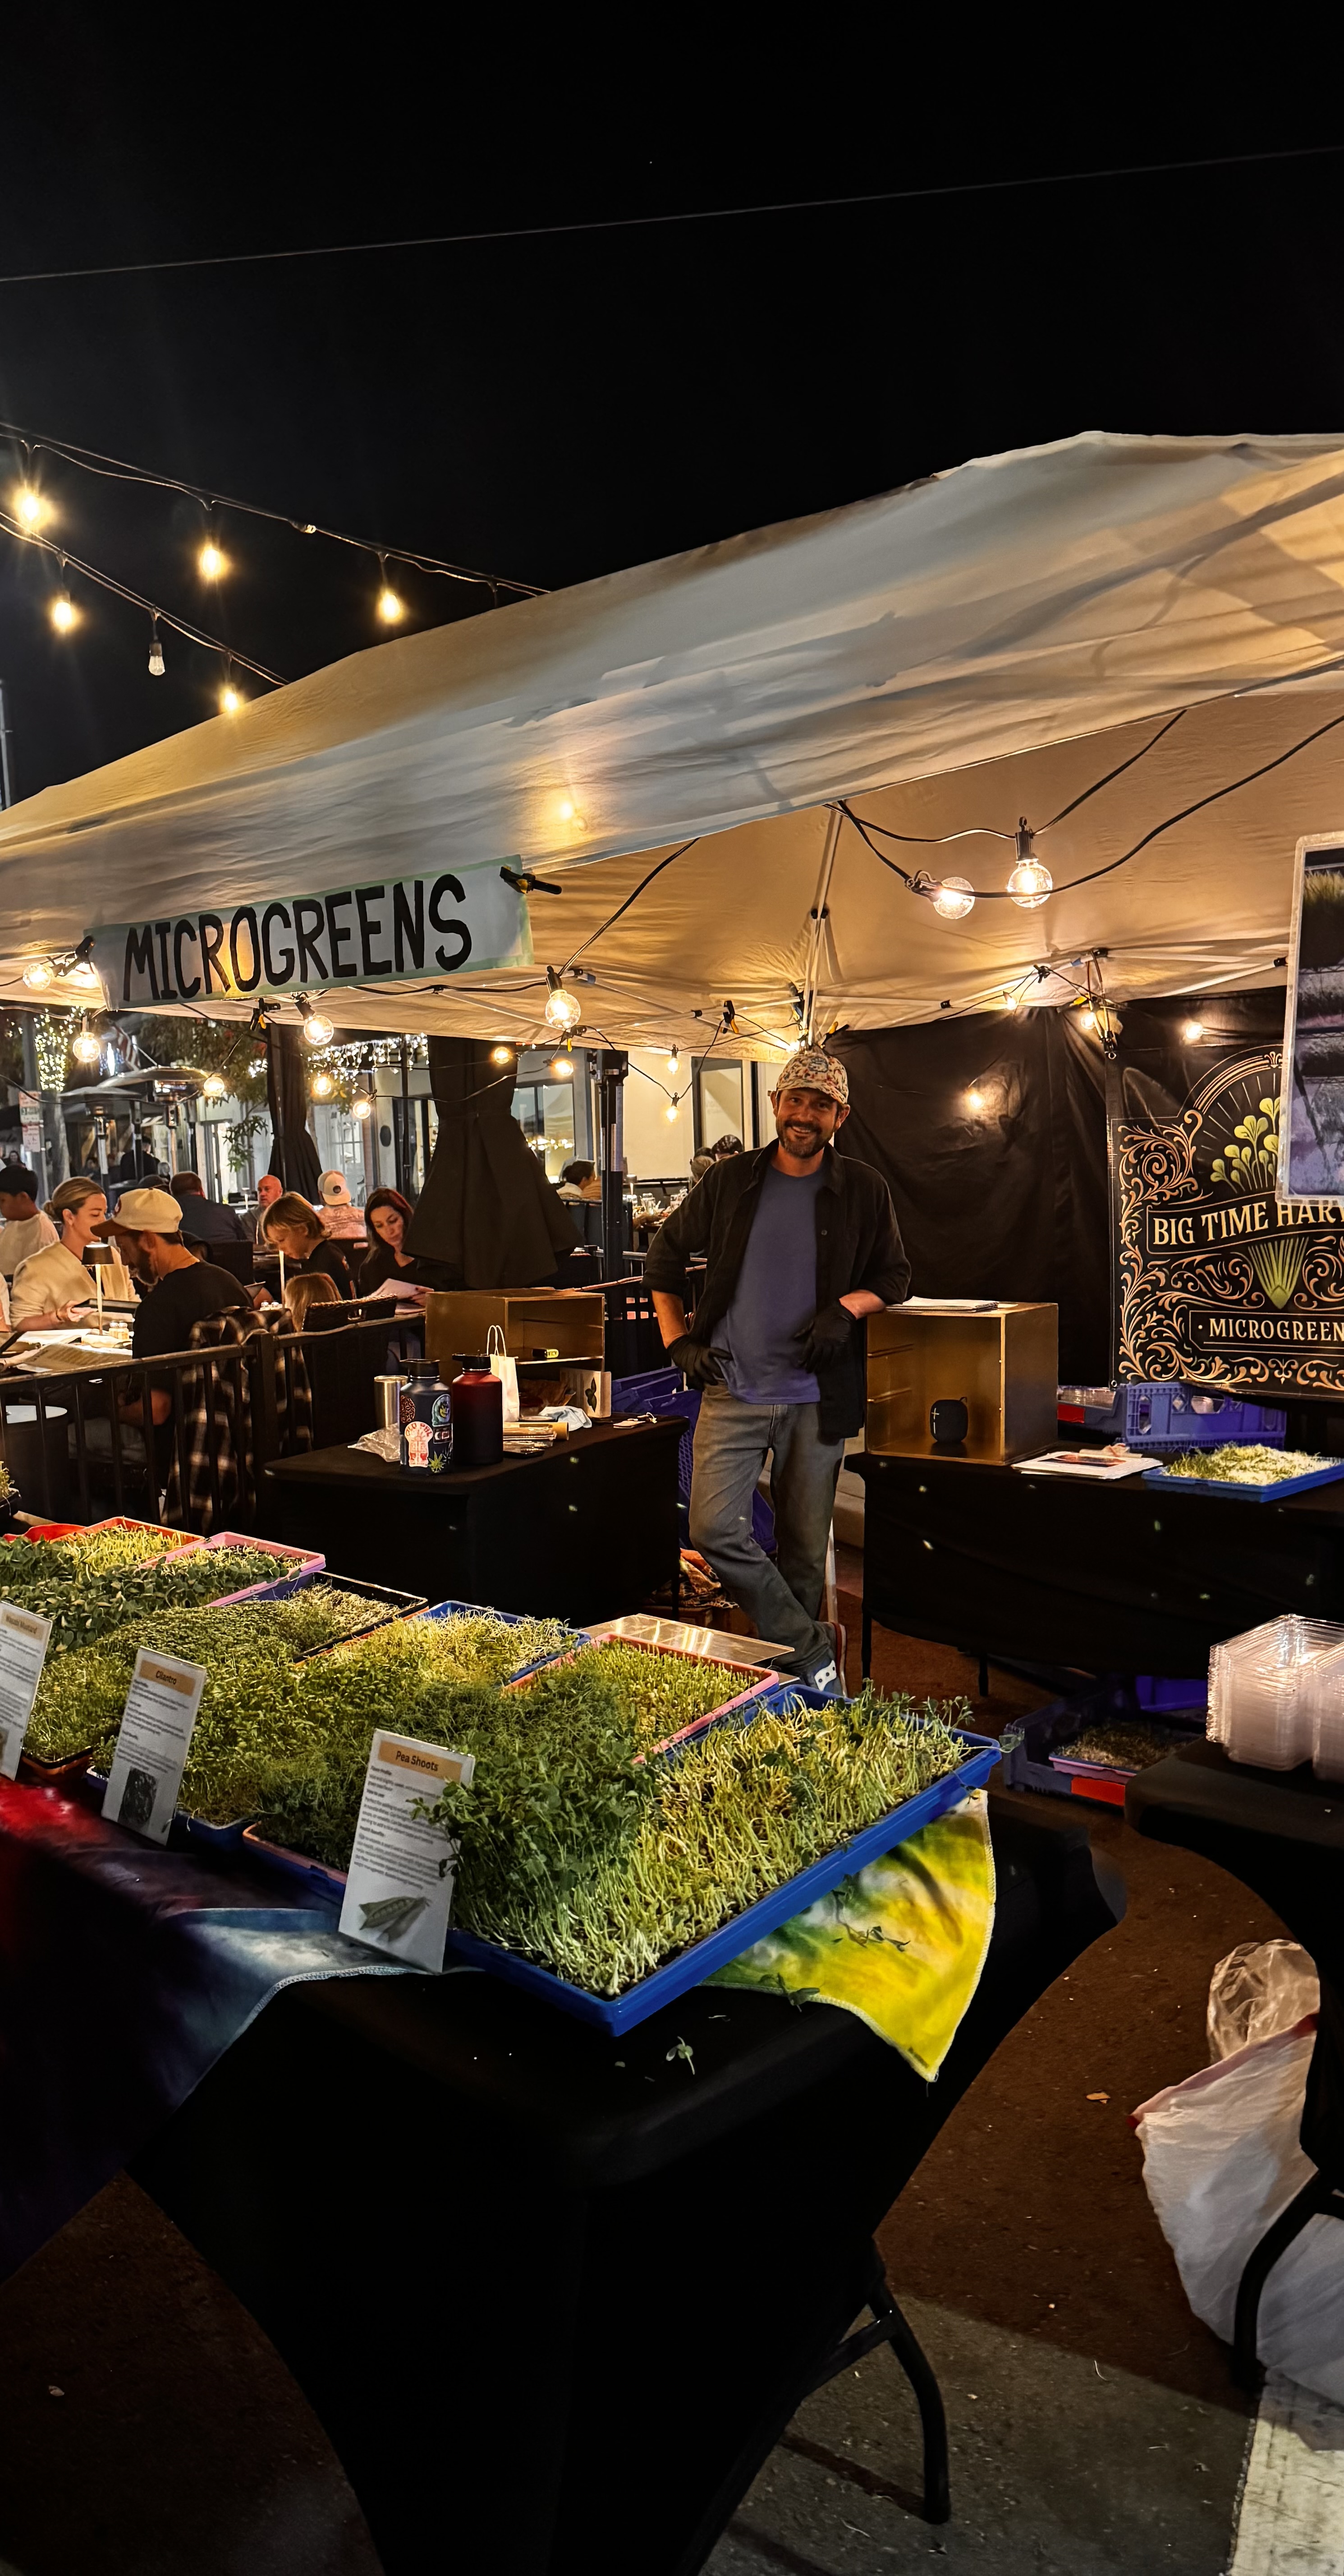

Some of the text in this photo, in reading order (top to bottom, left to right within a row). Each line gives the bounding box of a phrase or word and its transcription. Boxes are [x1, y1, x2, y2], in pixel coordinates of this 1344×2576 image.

[124, 874, 472, 1002] MICROGREENS
[1153, 1218, 1196, 1245] BIG
[1201, 1201, 1269, 1242] TIME
[156, 1670, 177, 1685] Cilantro
[396, 1750, 439, 1771] Pea Shoots
